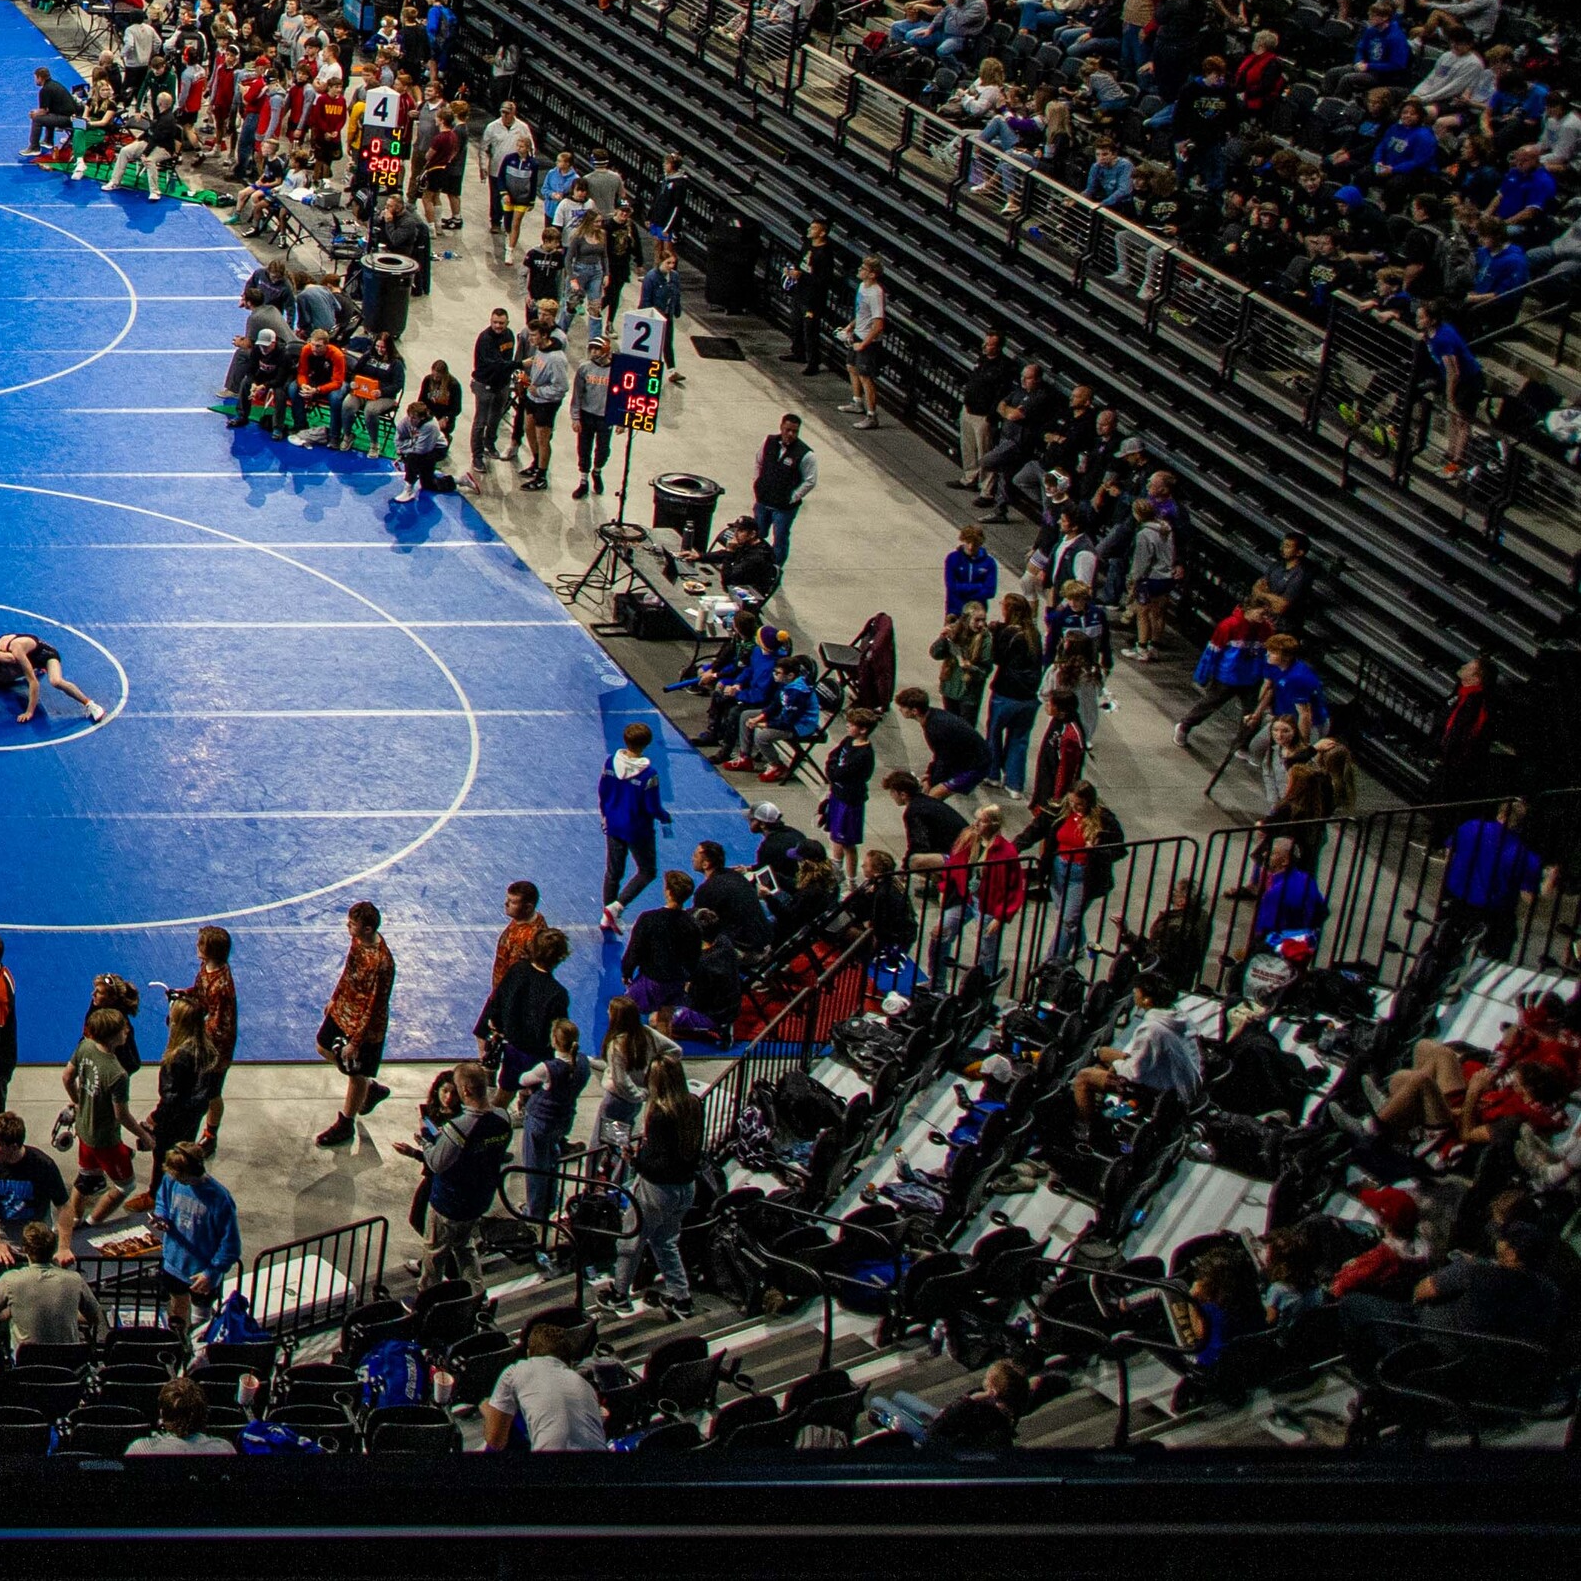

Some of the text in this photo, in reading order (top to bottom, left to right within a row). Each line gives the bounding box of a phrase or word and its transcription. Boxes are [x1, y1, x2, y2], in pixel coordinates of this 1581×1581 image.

[373, 97, 388, 122] 4
[369, 157, 399, 172] 2:00
[373, 171, 396, 185] 126
[632, 321, 651, 353] 2
[628, 396, 658, 415] 1:52
[624, 413, 654, 431] 126
